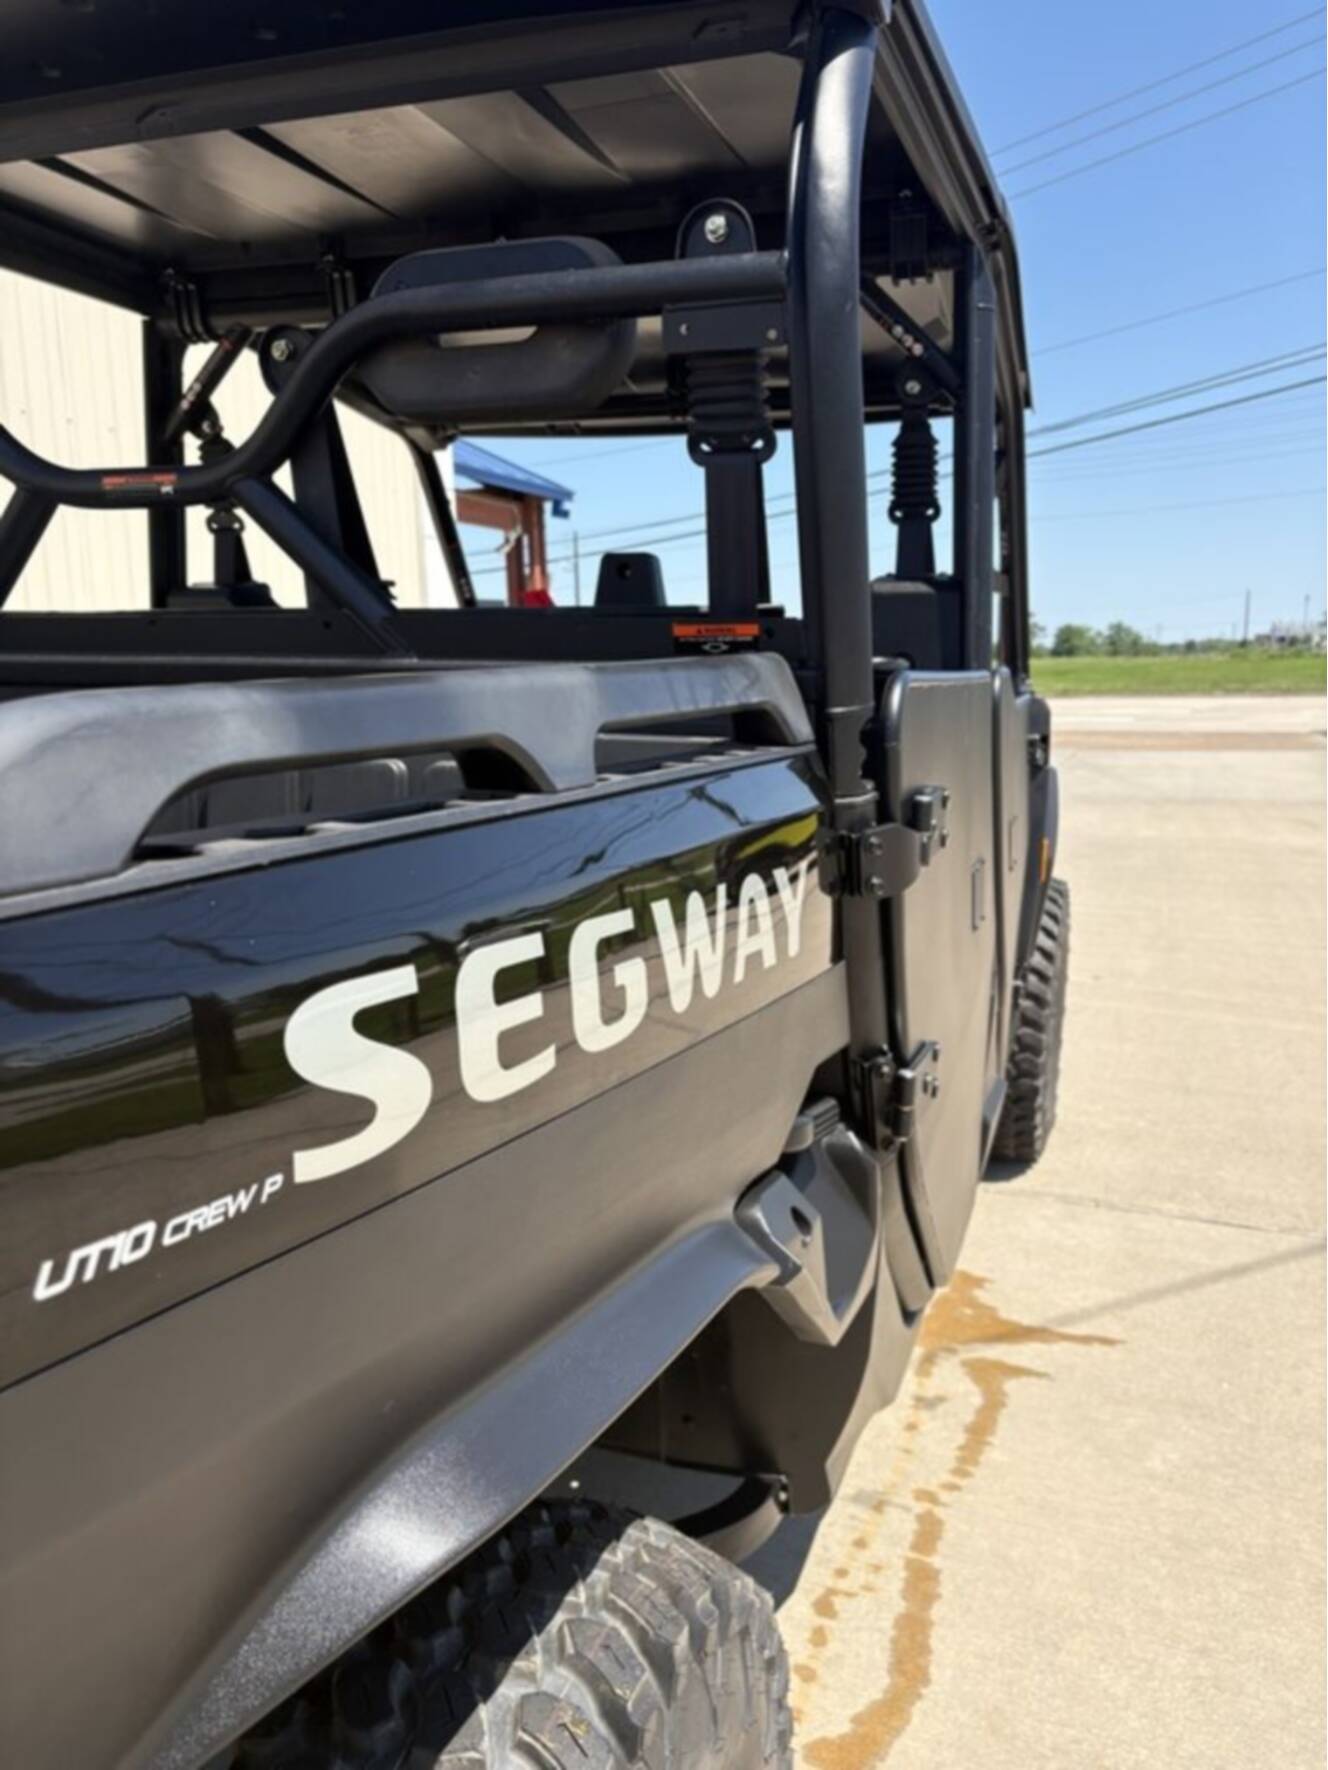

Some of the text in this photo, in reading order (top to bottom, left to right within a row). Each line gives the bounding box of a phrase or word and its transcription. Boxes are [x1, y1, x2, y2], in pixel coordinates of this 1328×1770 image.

[284, 861, 809, 1184] SEGWAY
[33, 1172, 284, 1301] UT10 CREW P
